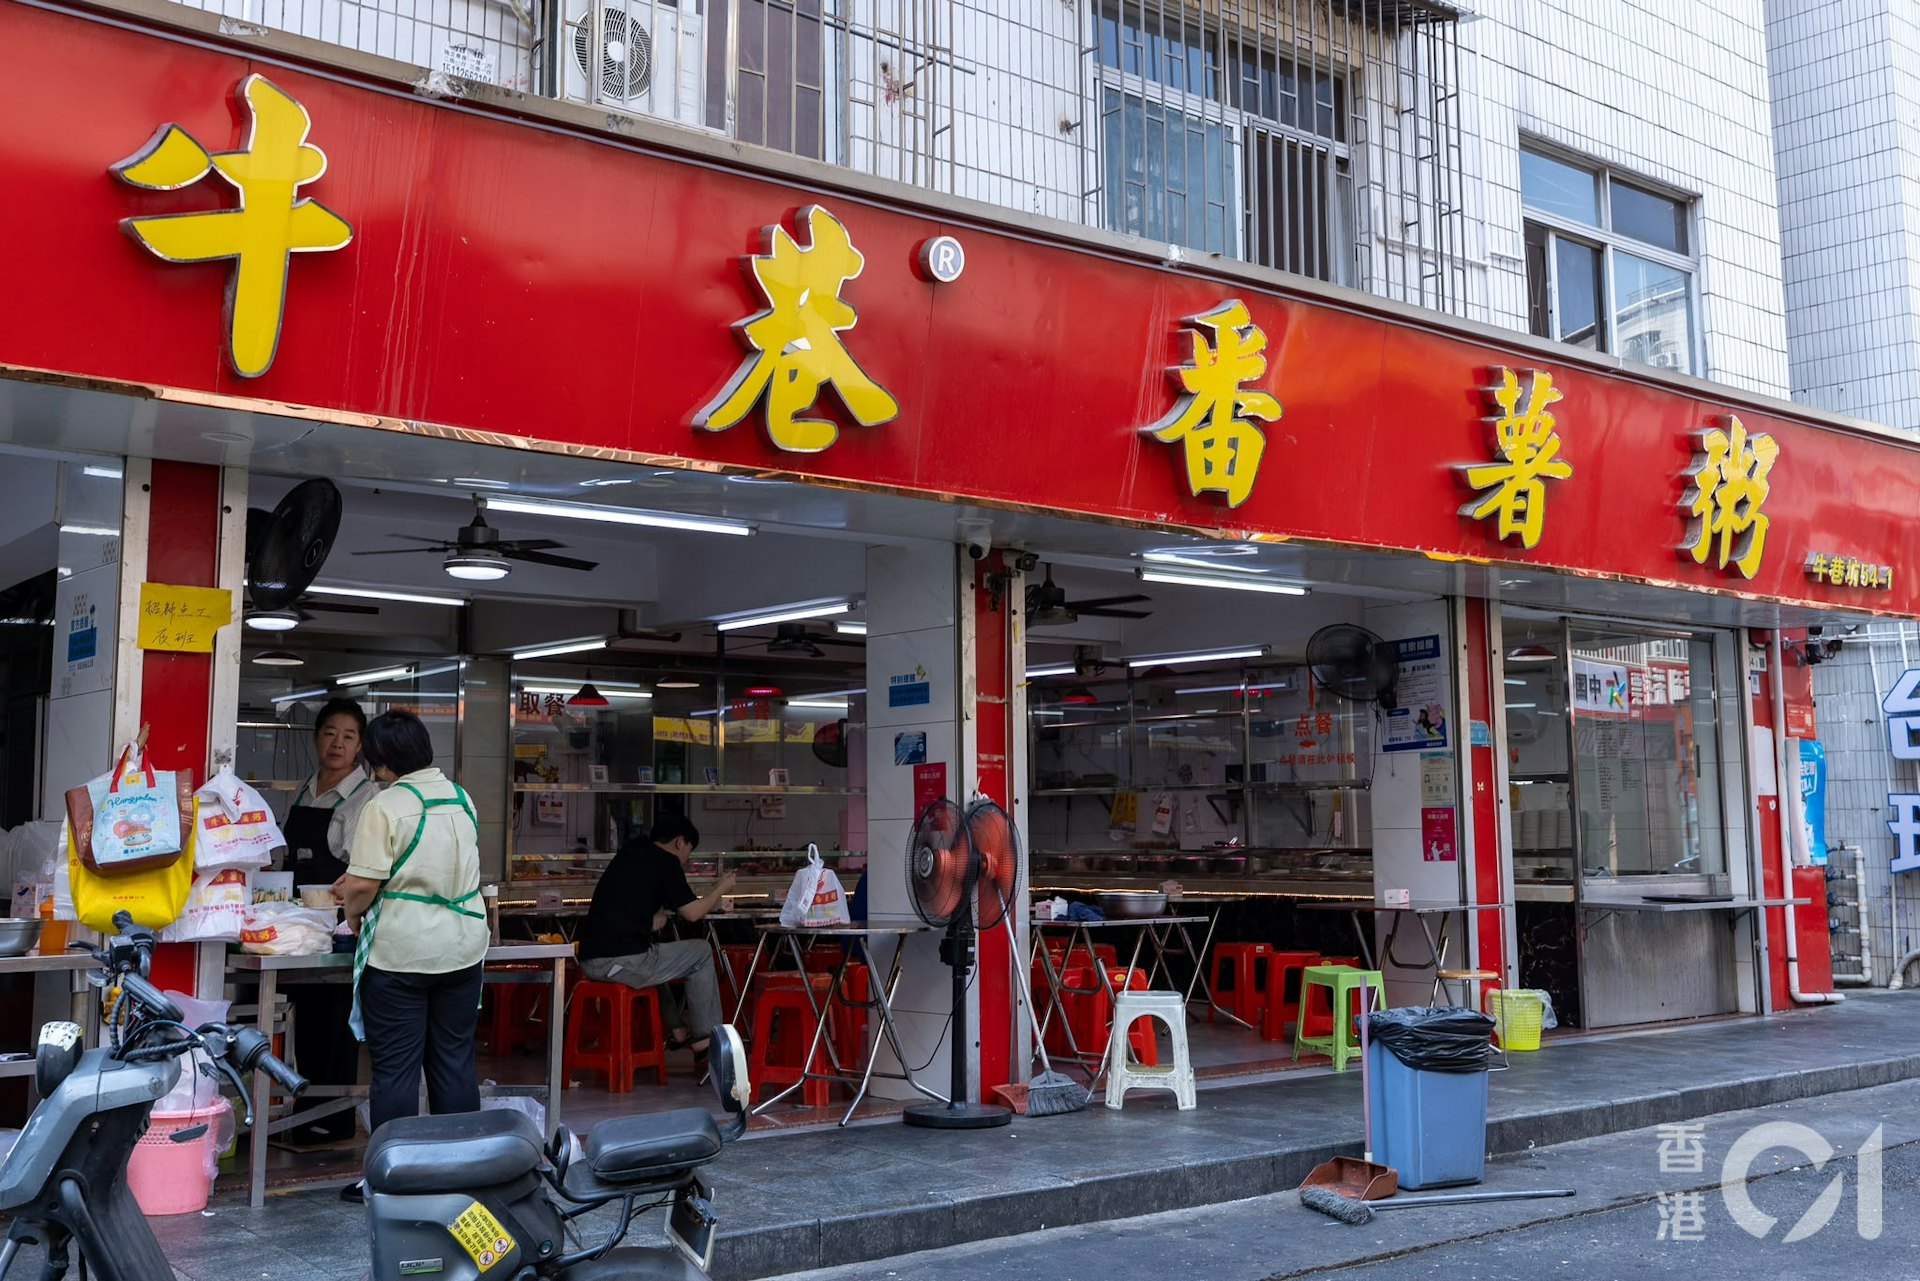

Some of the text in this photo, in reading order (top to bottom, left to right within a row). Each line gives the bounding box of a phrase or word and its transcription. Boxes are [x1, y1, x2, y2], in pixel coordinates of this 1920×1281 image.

[1812, 553, 1893, 590] 牛巷坊54-1
[519, 692, 565, 717] 取餐
[1295, 710, 1333, 737] 点餐
